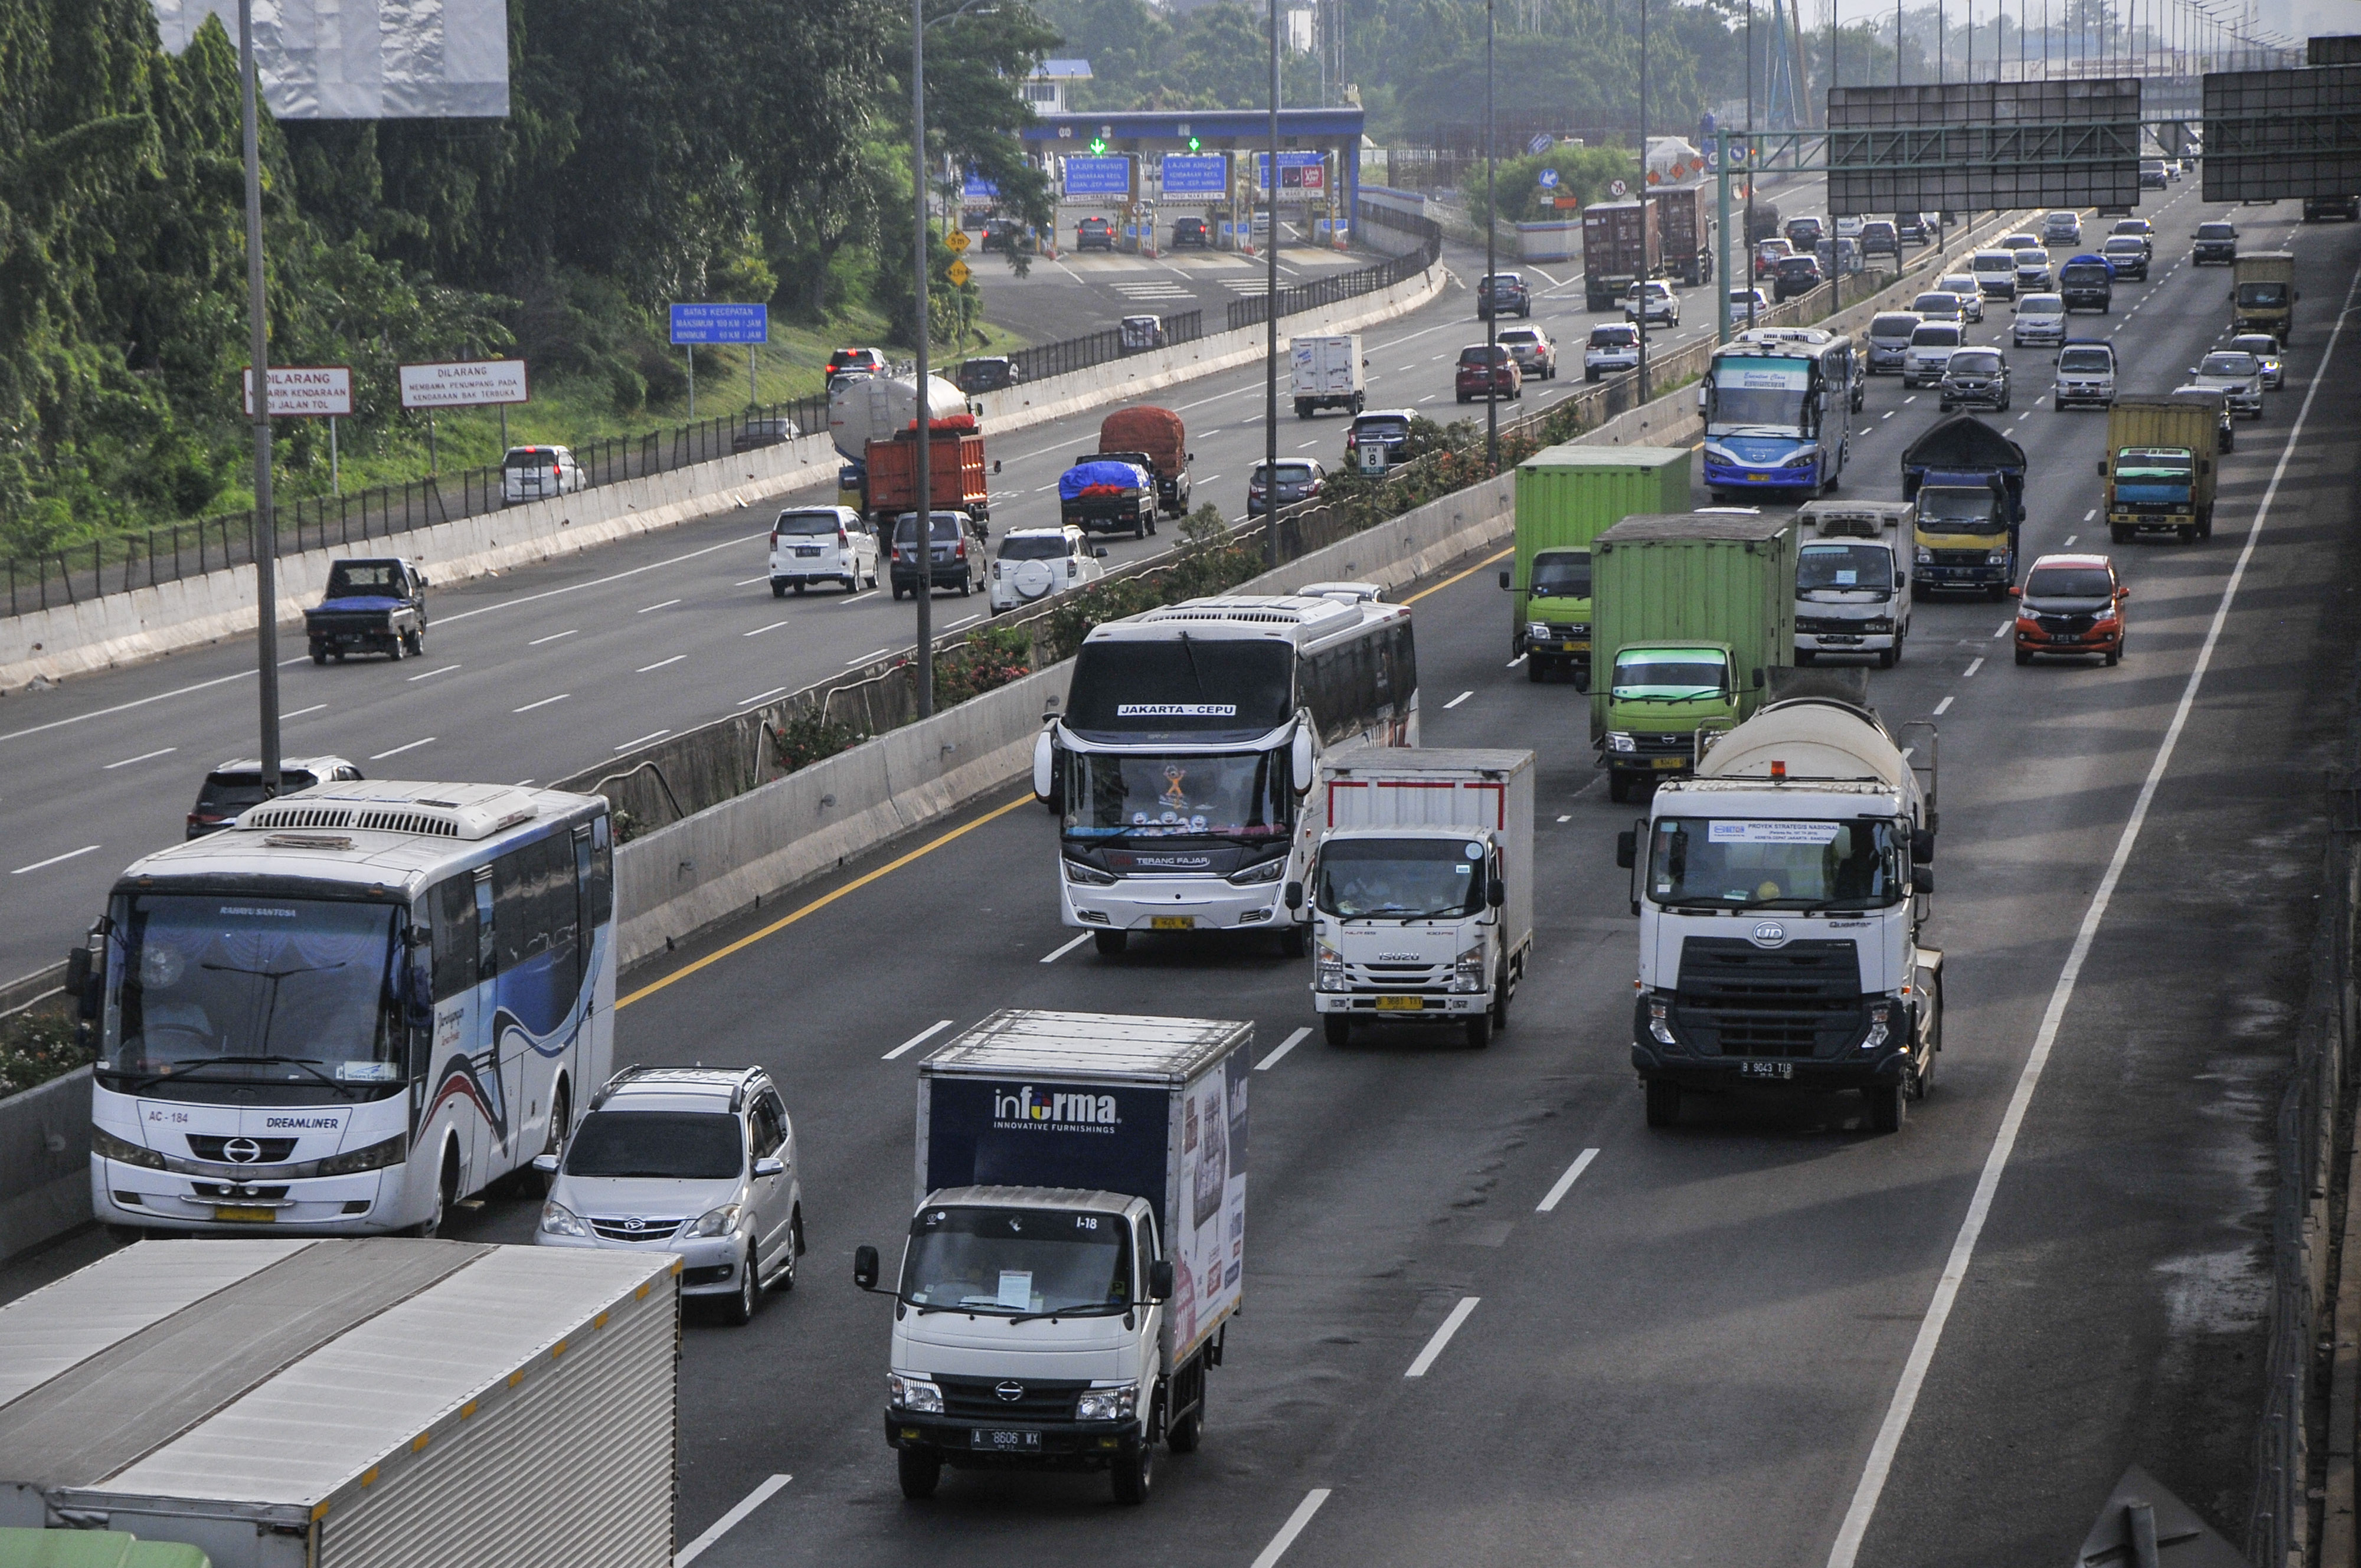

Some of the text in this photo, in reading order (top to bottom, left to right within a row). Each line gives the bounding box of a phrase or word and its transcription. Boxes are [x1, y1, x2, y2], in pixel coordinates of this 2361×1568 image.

[684, 307, 754, 316] BATAS KECEPATAN
[437, 366, 487, 377] DILARANG
[266, 374, 330, 384] DILARANG
[450, 381, 495, 389] PENUMPANG
[292, 388, 346, 397] KENDARAAN
[413, 389, 515, 401] KENDARAAN BAK TERBUKA
[279, 400, 309, 409] JALAN
[313, 400, 328, 408] TOL
[1369, 454, 1376, 465] 8
[1197, 706, 1233, 714] CEPU
[1379, 952, 1420, 960] ISUZU
[1742, 1062, 1748, 1072] B
[1753, 1062, 1773, 1072] 9043
[995, 1085, 1116, 1124] informa
[149, 1111, 162, 1121] AC
[171, 1112, 188, 1122] 184
[266, 1118, 339, 1129] DREAMLINER
[993, 1121, 1115, 1134] INNOVATIVE FURNISHINGS
[1076, 1216, 1098, 1229] I-18
[974, 1430, 1038, 1445] A 8606 WX
